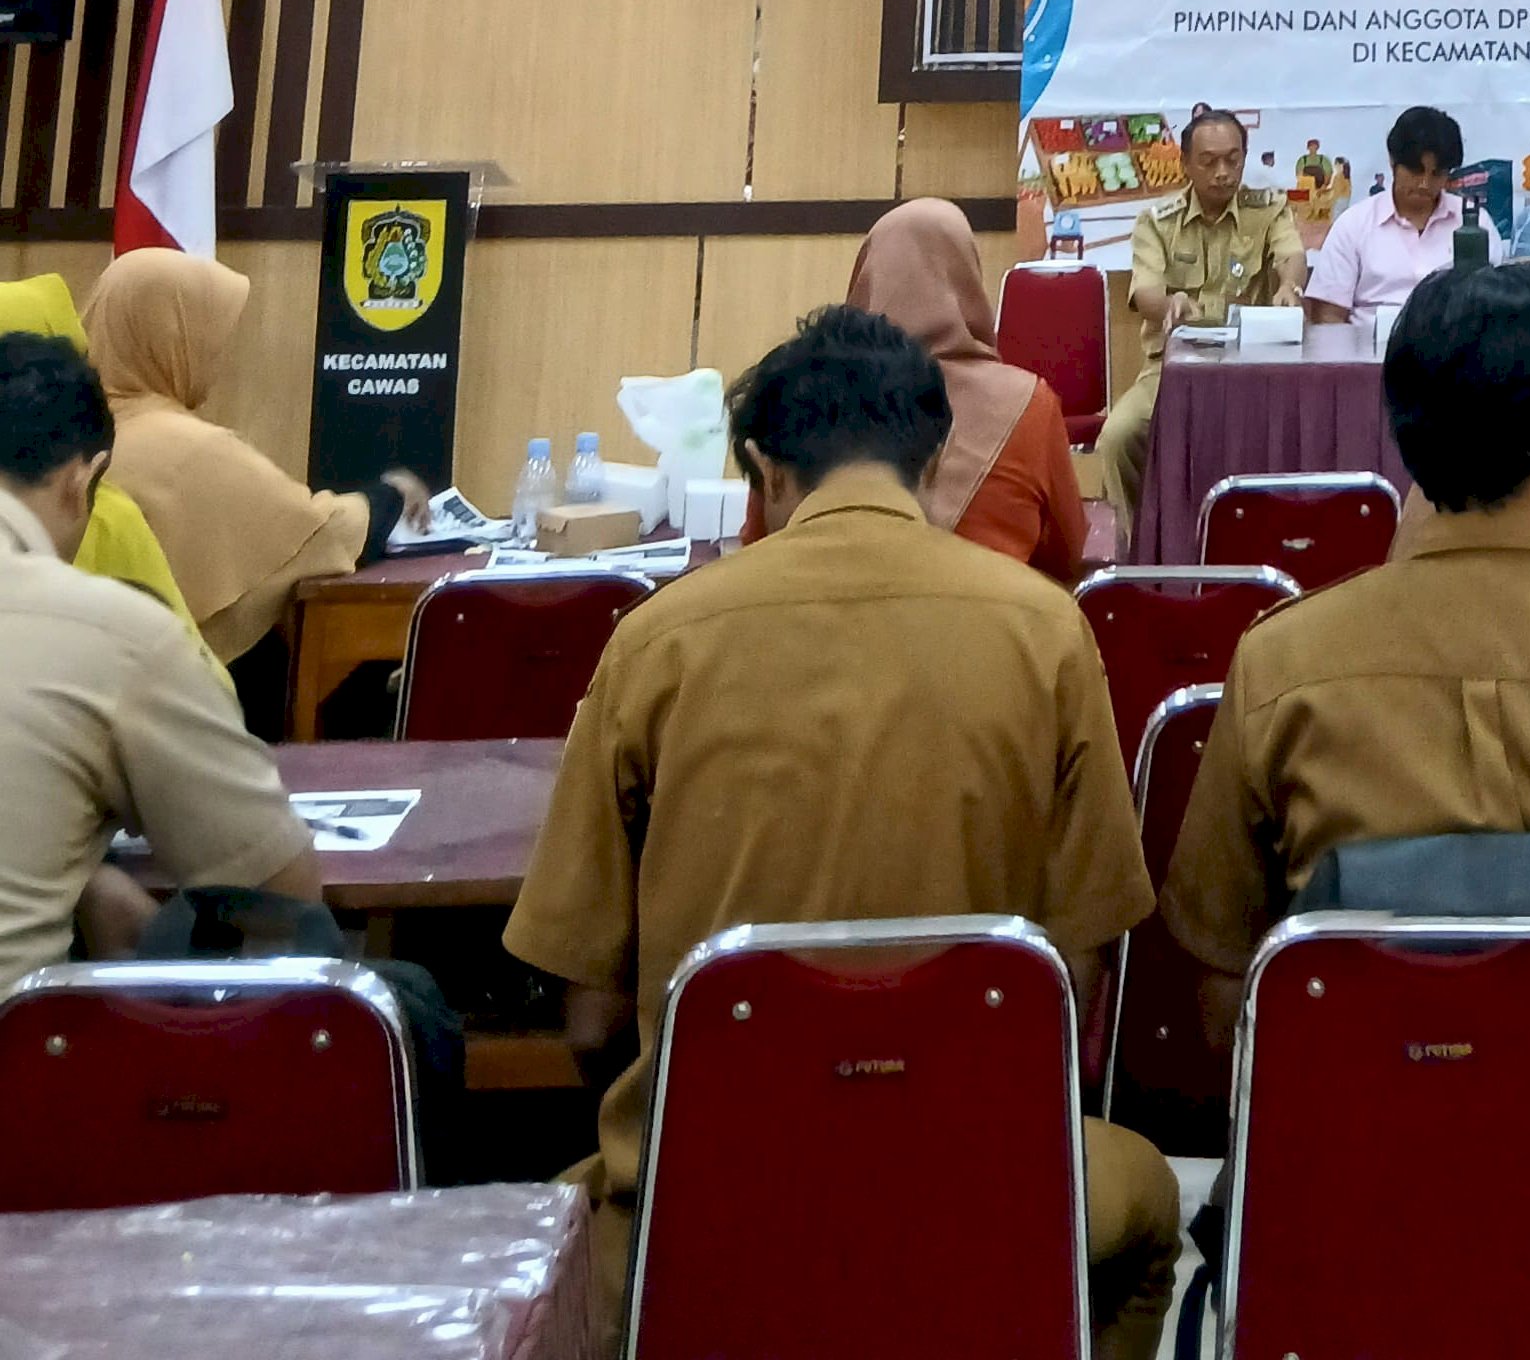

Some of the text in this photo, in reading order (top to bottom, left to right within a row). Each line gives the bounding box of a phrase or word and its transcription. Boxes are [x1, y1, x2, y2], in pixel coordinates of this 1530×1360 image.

[1174, 9, 1294, 33] PIMPINAN
[1302, 9, 1357, 32] DAN
[1364, 7, 1490, 31] ANGGOTA
[1352, 41, 1377, 64] DI
[323, 353, 448, 371] KECAMATAN
[347, 378, 420, 396] CAWAS
